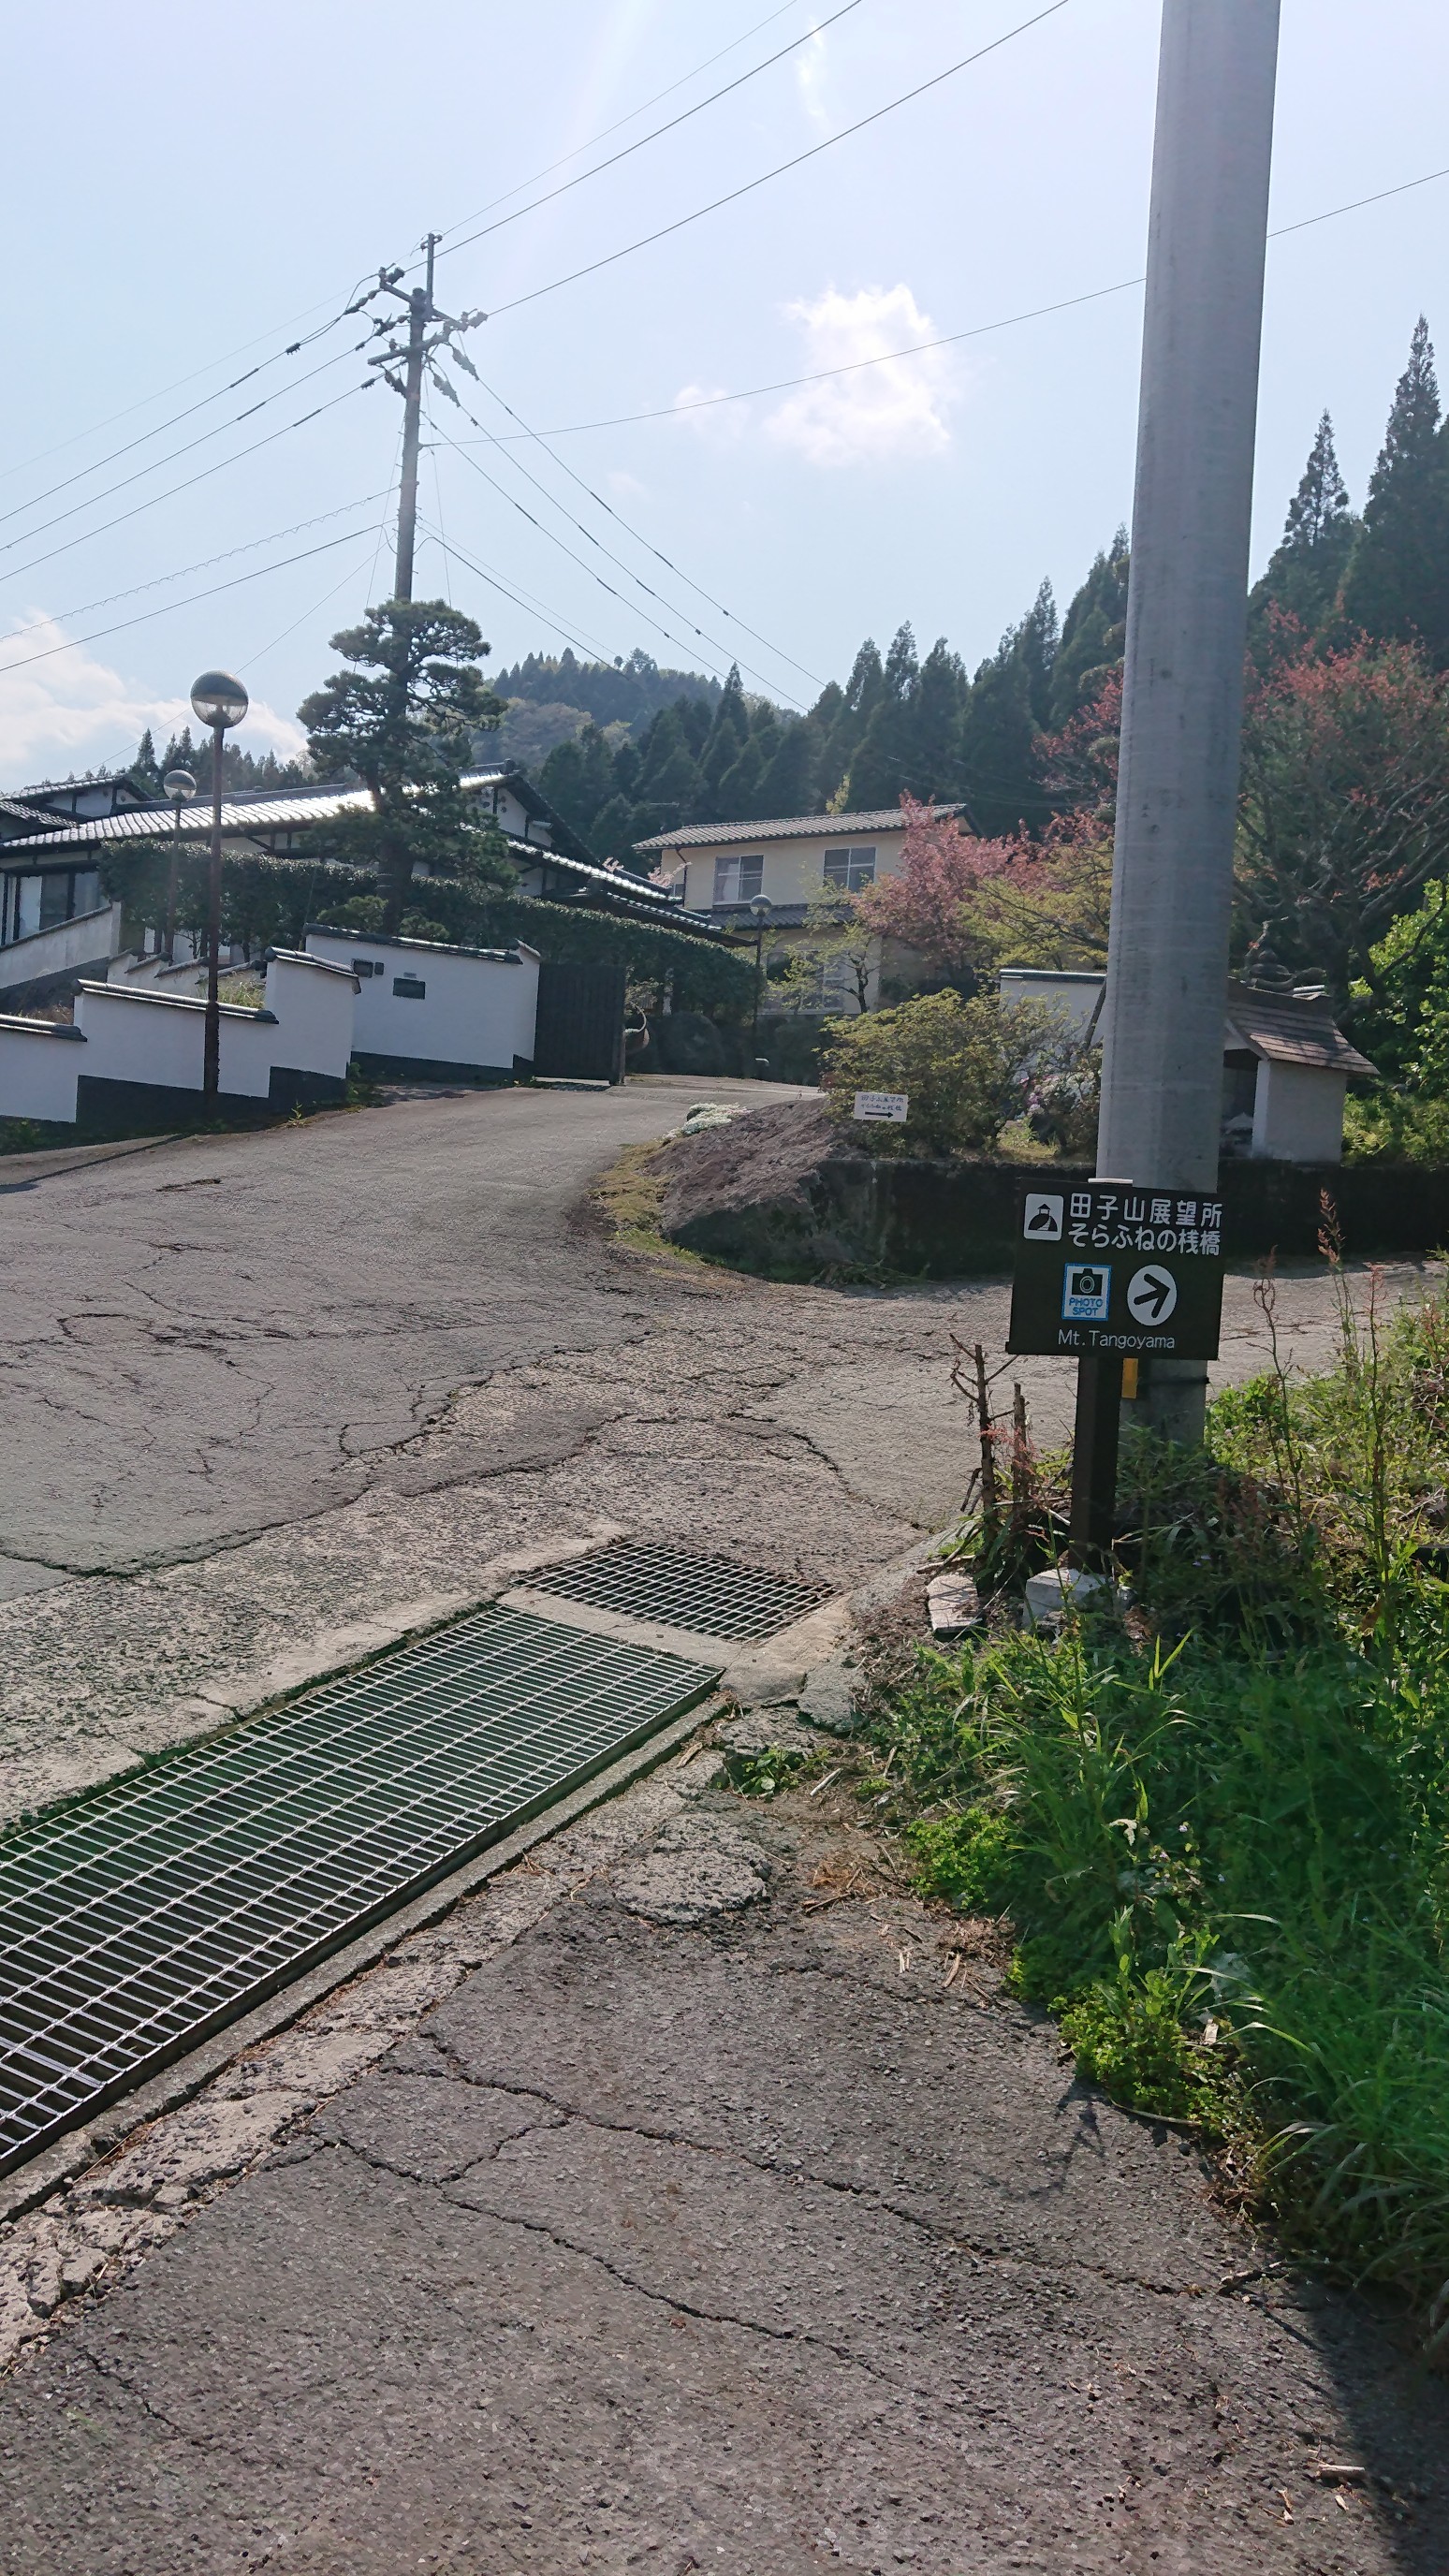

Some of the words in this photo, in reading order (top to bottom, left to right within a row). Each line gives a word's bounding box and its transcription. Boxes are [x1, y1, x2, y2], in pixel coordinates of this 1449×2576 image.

[1069, 1193, 1223, 1228] 田子山展望所
[1068, 1222, 1221, 1256] そらふねの桟橋
[1069, 1297, 1103, 1308] PHOTO
[1072, 1308, 1099, 1316] SPOT
[1058, 1329, 1086, 1346] Mt.
[1089, 1330, 1176, 1350] Tangoyama
